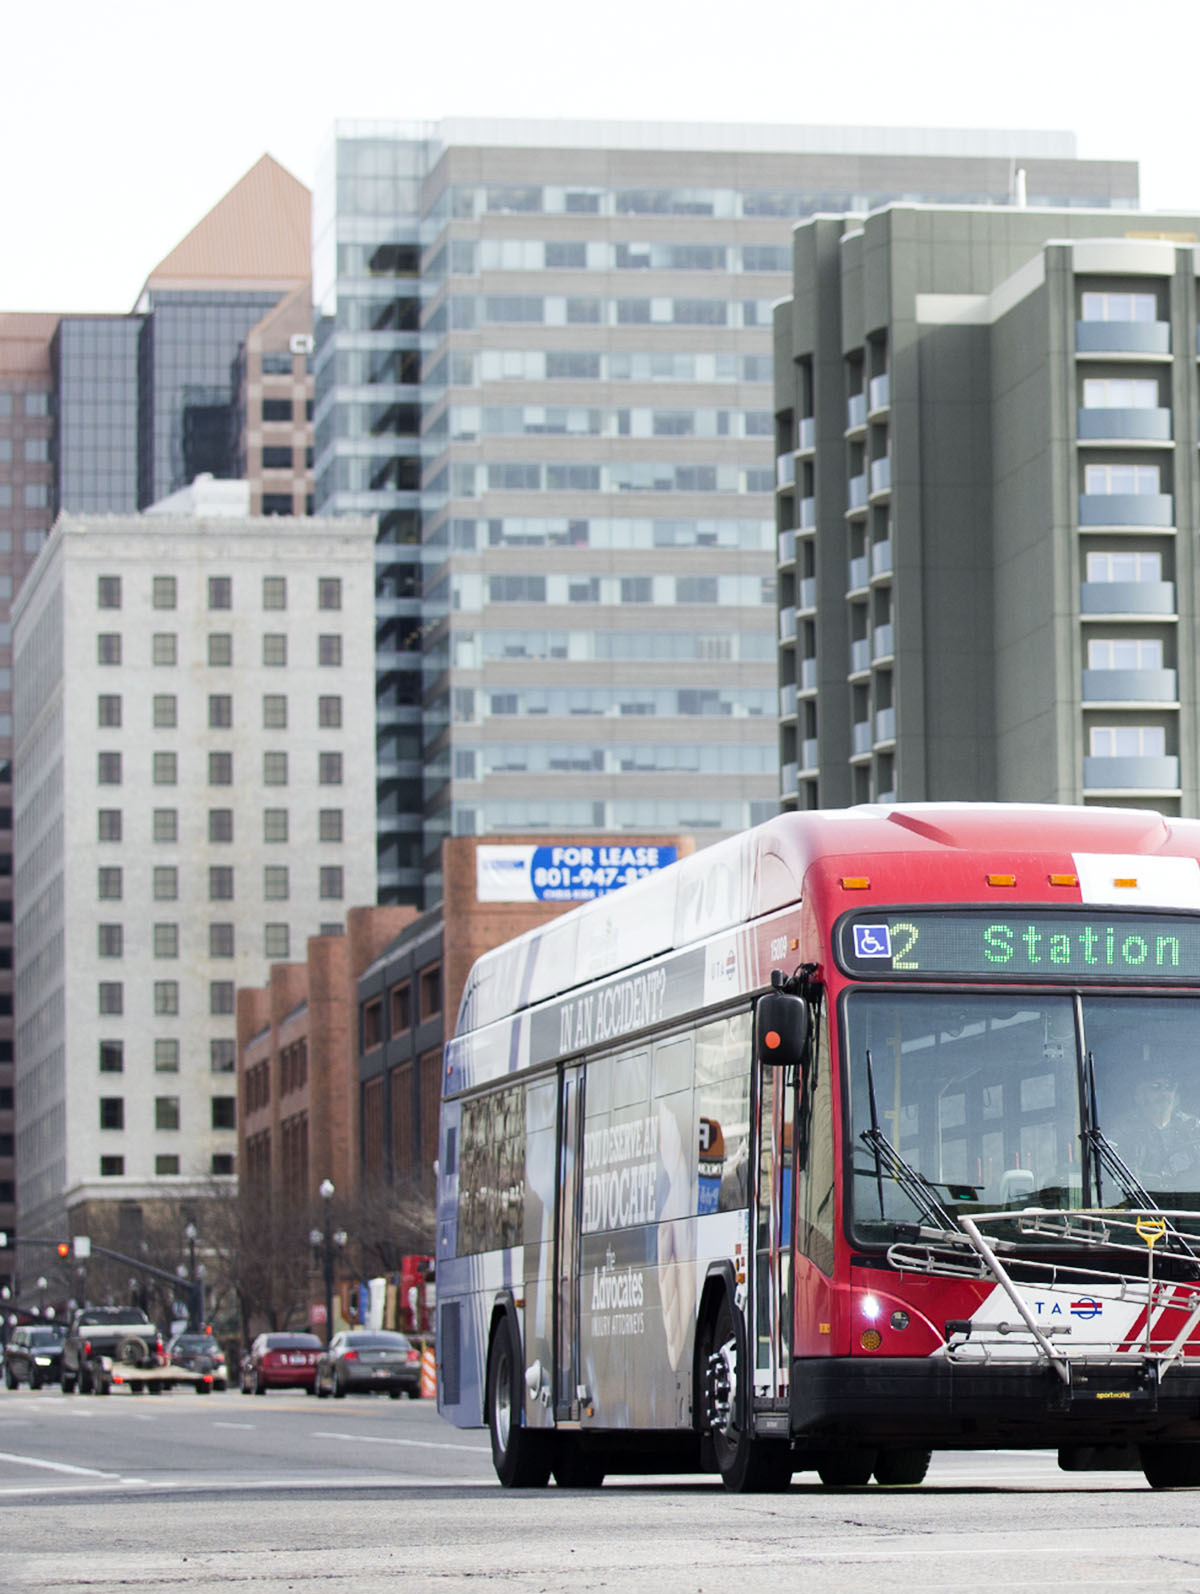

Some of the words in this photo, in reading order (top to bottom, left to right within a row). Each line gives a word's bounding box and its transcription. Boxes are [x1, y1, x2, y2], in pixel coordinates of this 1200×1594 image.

[534, 867, 662, 888] 801-947-8
[551, 848, 594, 867] FOR
[599, 848, 659, 867] LEASE
[889, 923, 919, 970] 2
[984, 924, 1180, 966] Station
[560, 1006, 573, 1054] IN
[574, 998, 595, 1048] AN
[595, 967, 667, 1040] ACCIDENT?
[582, 1161, 658, 1234] ADVOCATE
[592, 1266, 644, 1310] Advocates
[1025, 1302, 1063, 1314] TA
